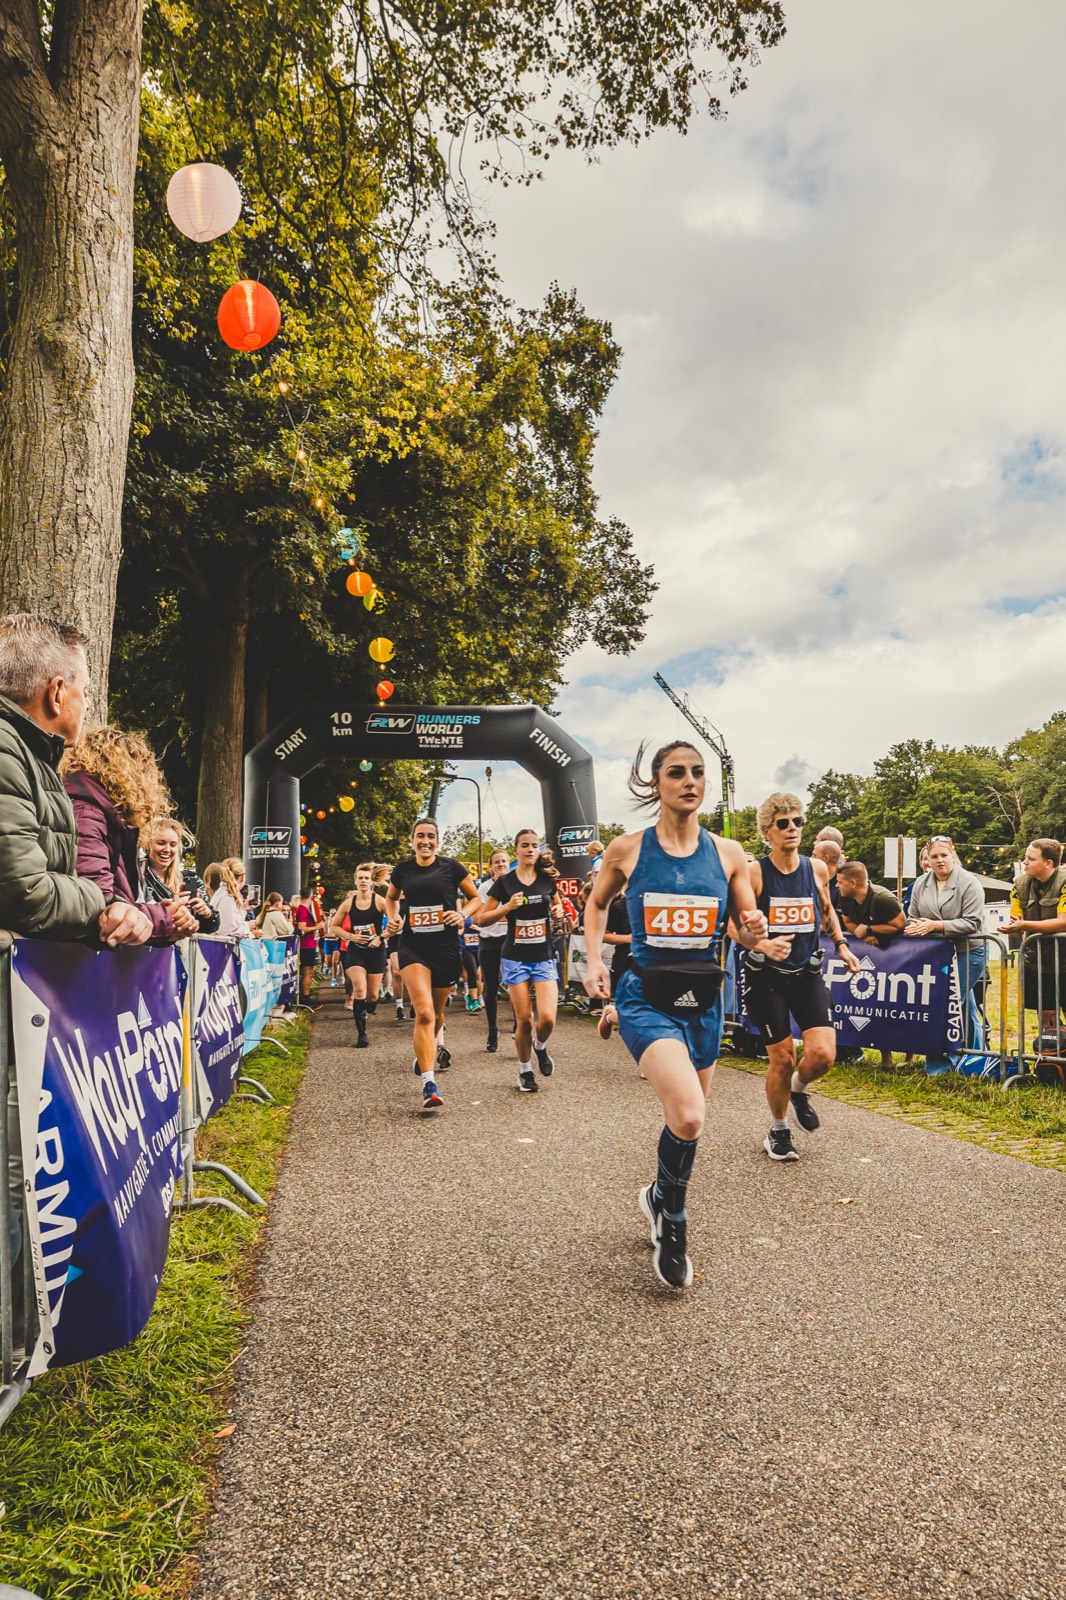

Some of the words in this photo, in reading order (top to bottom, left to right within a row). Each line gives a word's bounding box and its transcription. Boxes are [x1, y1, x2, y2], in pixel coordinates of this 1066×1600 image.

[330, 712, 353, 725] 10
[416, 714, 481, 725] RUNNERS
[332, 726, 353, 737] km
[416, 724, 463, 735] WORLD
[274, 727, 307, 760] START
[418, 736, 464, 745] TWENTE
[528, 727, 572, 767] FINISH
[251, 847, 290, 855] TWENTE
[561, 845, 588, 854] TWEN
[414, 912, 440, 926] 525
[651, 909, 709, 934] 485
[774, 906, 811, 923] 590
[518, 925, 544, 937] 488
[822, 959, 936, 1006] Point
[834, 1004, 929, 1022] OMMUNICATIE
[52, 995, 184, 1176] WayPoin
[114, 1152, 150, 1229] NAVIGATIE
